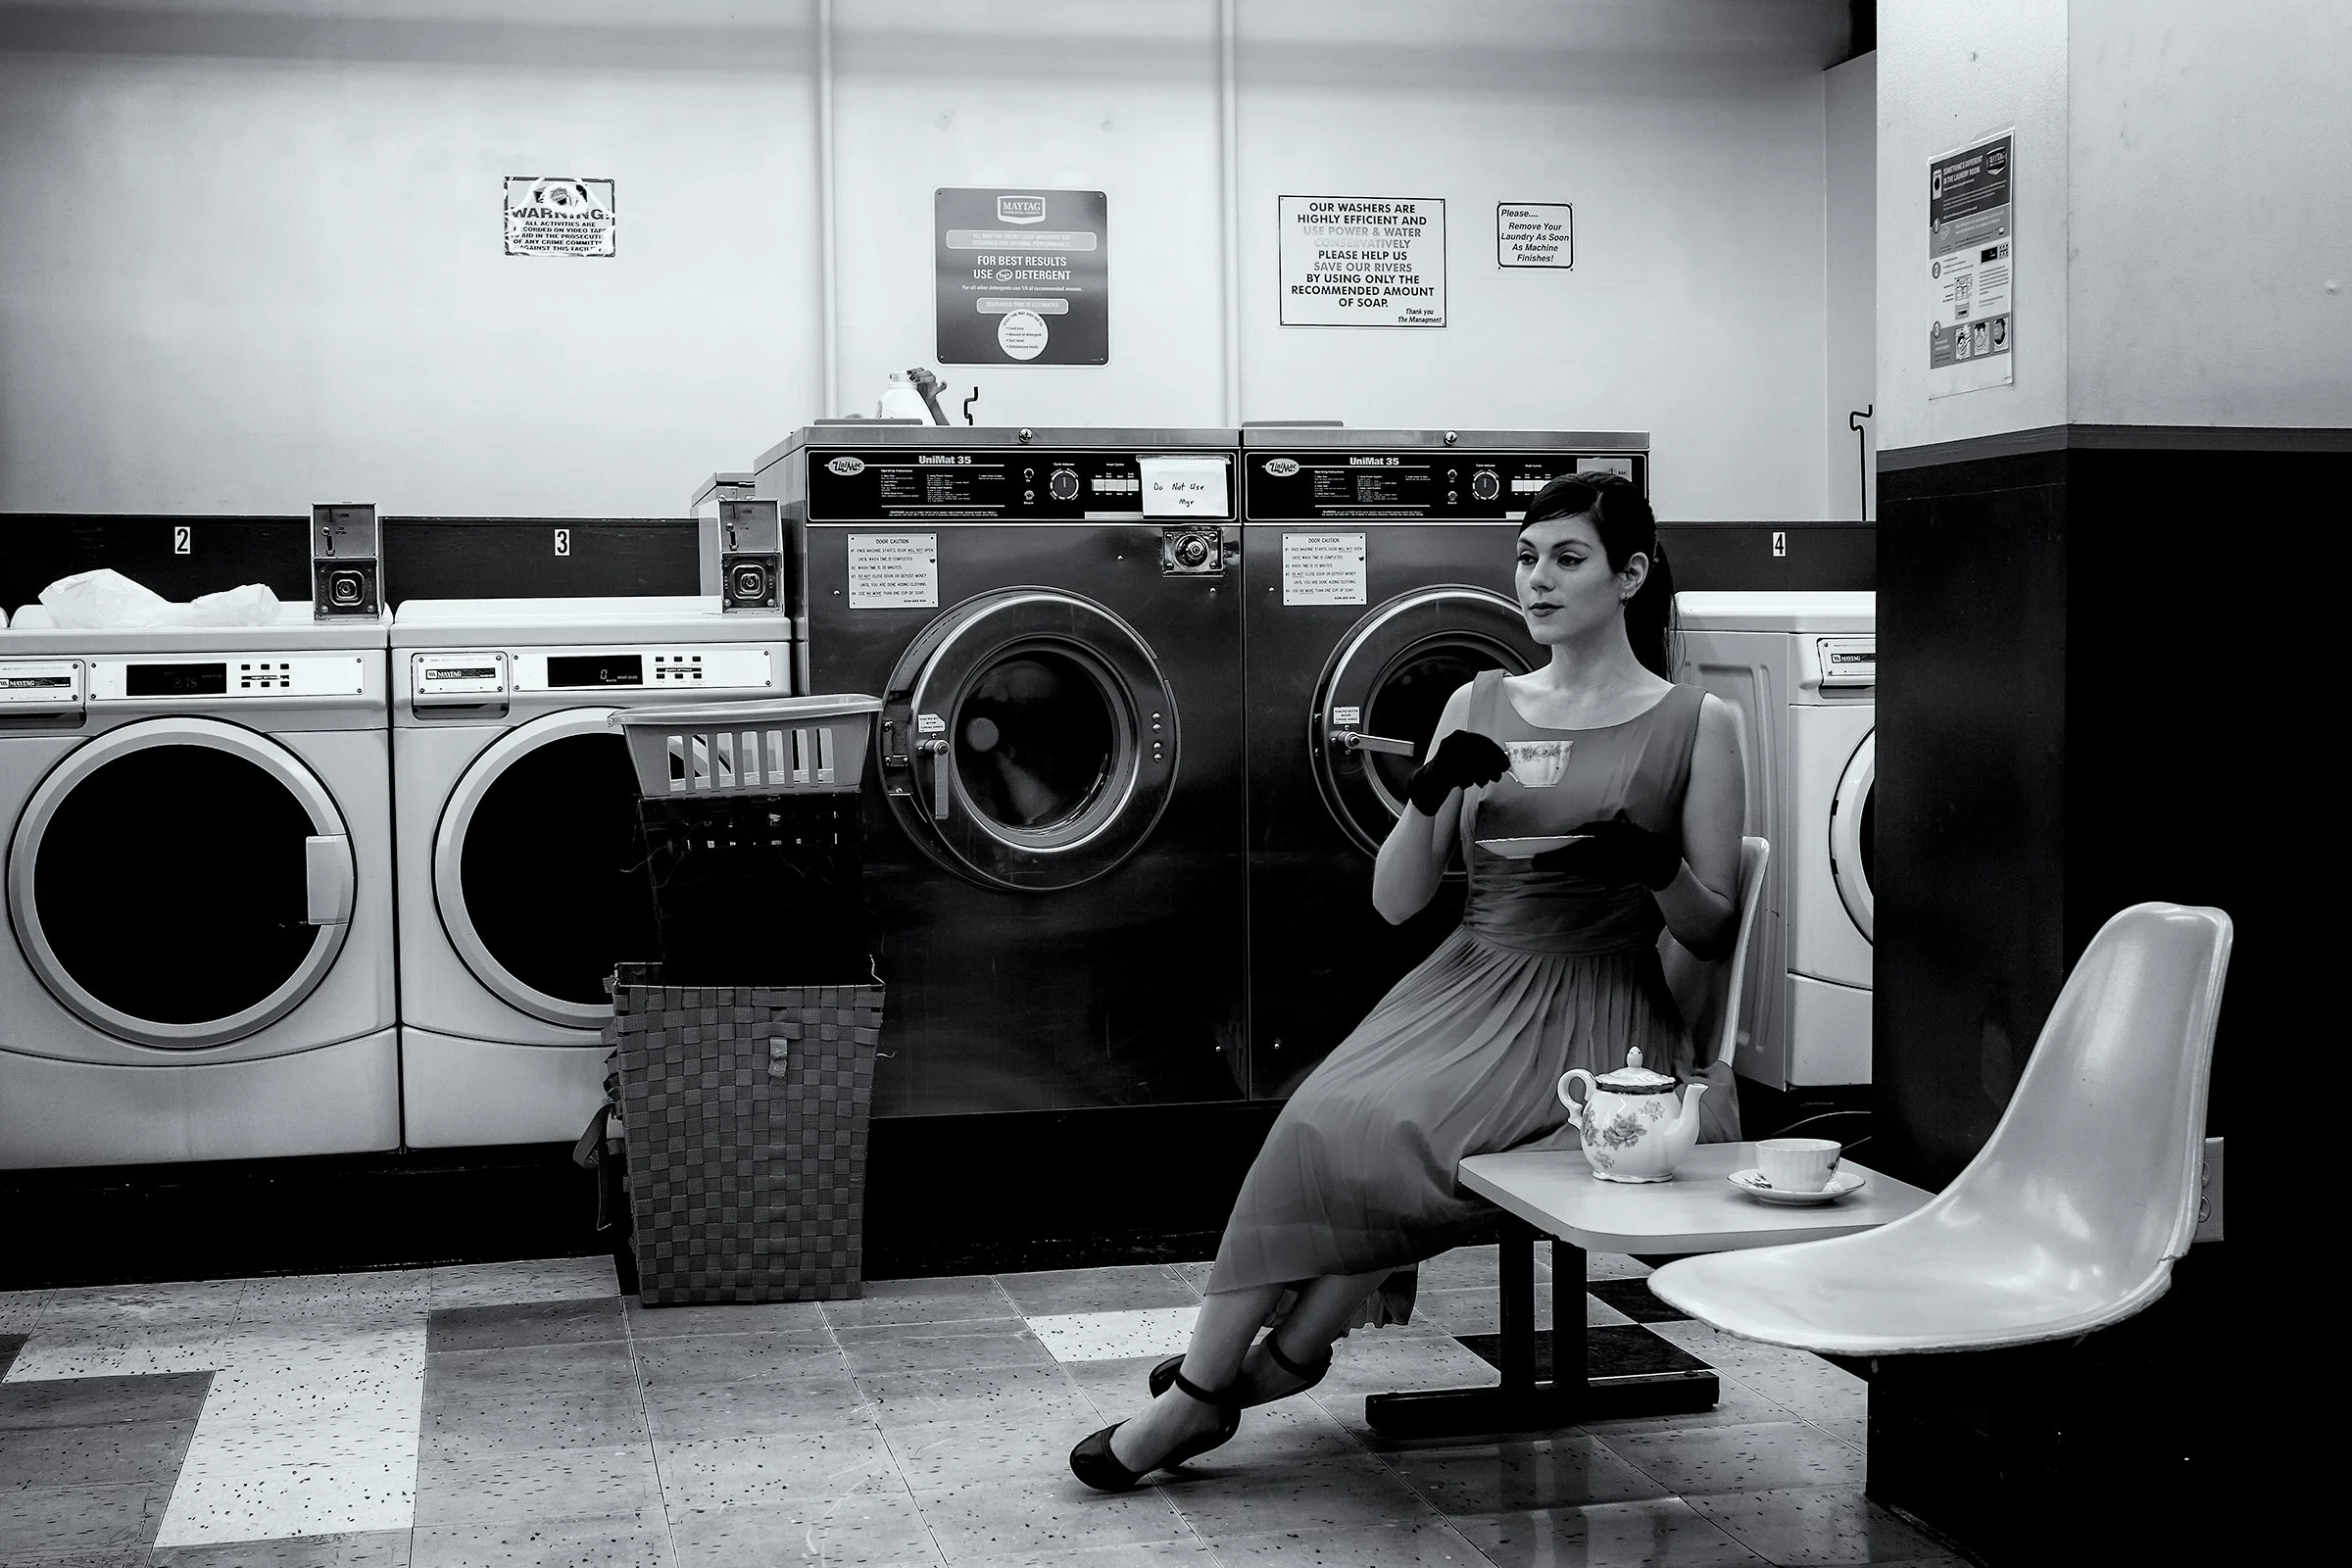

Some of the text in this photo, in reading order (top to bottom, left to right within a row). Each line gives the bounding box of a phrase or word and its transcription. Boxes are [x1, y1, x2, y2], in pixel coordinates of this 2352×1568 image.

[1004, 202, 1041, 211] MAYTAG
[1309, 203, 1416, 214] OUR WASHERS ARE
[1298, 215, 1427, 225] HIGHLY EFFICIENT AND
[1303, 226, 1421, 237] USE POWER & WATER
[1501, 233, 1534, 242] Laundry
[1314, 238, 1411, 249] CONSERVATIVELY
[1318, 250, 1407, 261] PLEASE HELP US
[978, 256, 1066, 267] FOR BEST RESULTS
[1314, 262, 1412, 272] SAVE OUR RIVERS
[973, 270, 993, 278] USE
[1015, 270, 1071, 279] DETERGENT
[1306, 273, 1419, 284] BY USING ONLY THE
[1292, 285, 1434, 296] RECOMMENDED AMOUNT
[1339, 298, 1388, 308] OF SOAP.
[1349, 457, 1384, 466] UniMat
[1153, 482, 1163, 491] Do
[1172, 482, 1186, 491] Not
[1179, 499, 1195, 508] Mgr
[176, 528, 188, 553] 2
[557, 531, 567, 554] 3
[1774, 533, 1785, 555] 4
[600, 669, 608, 680] 0
